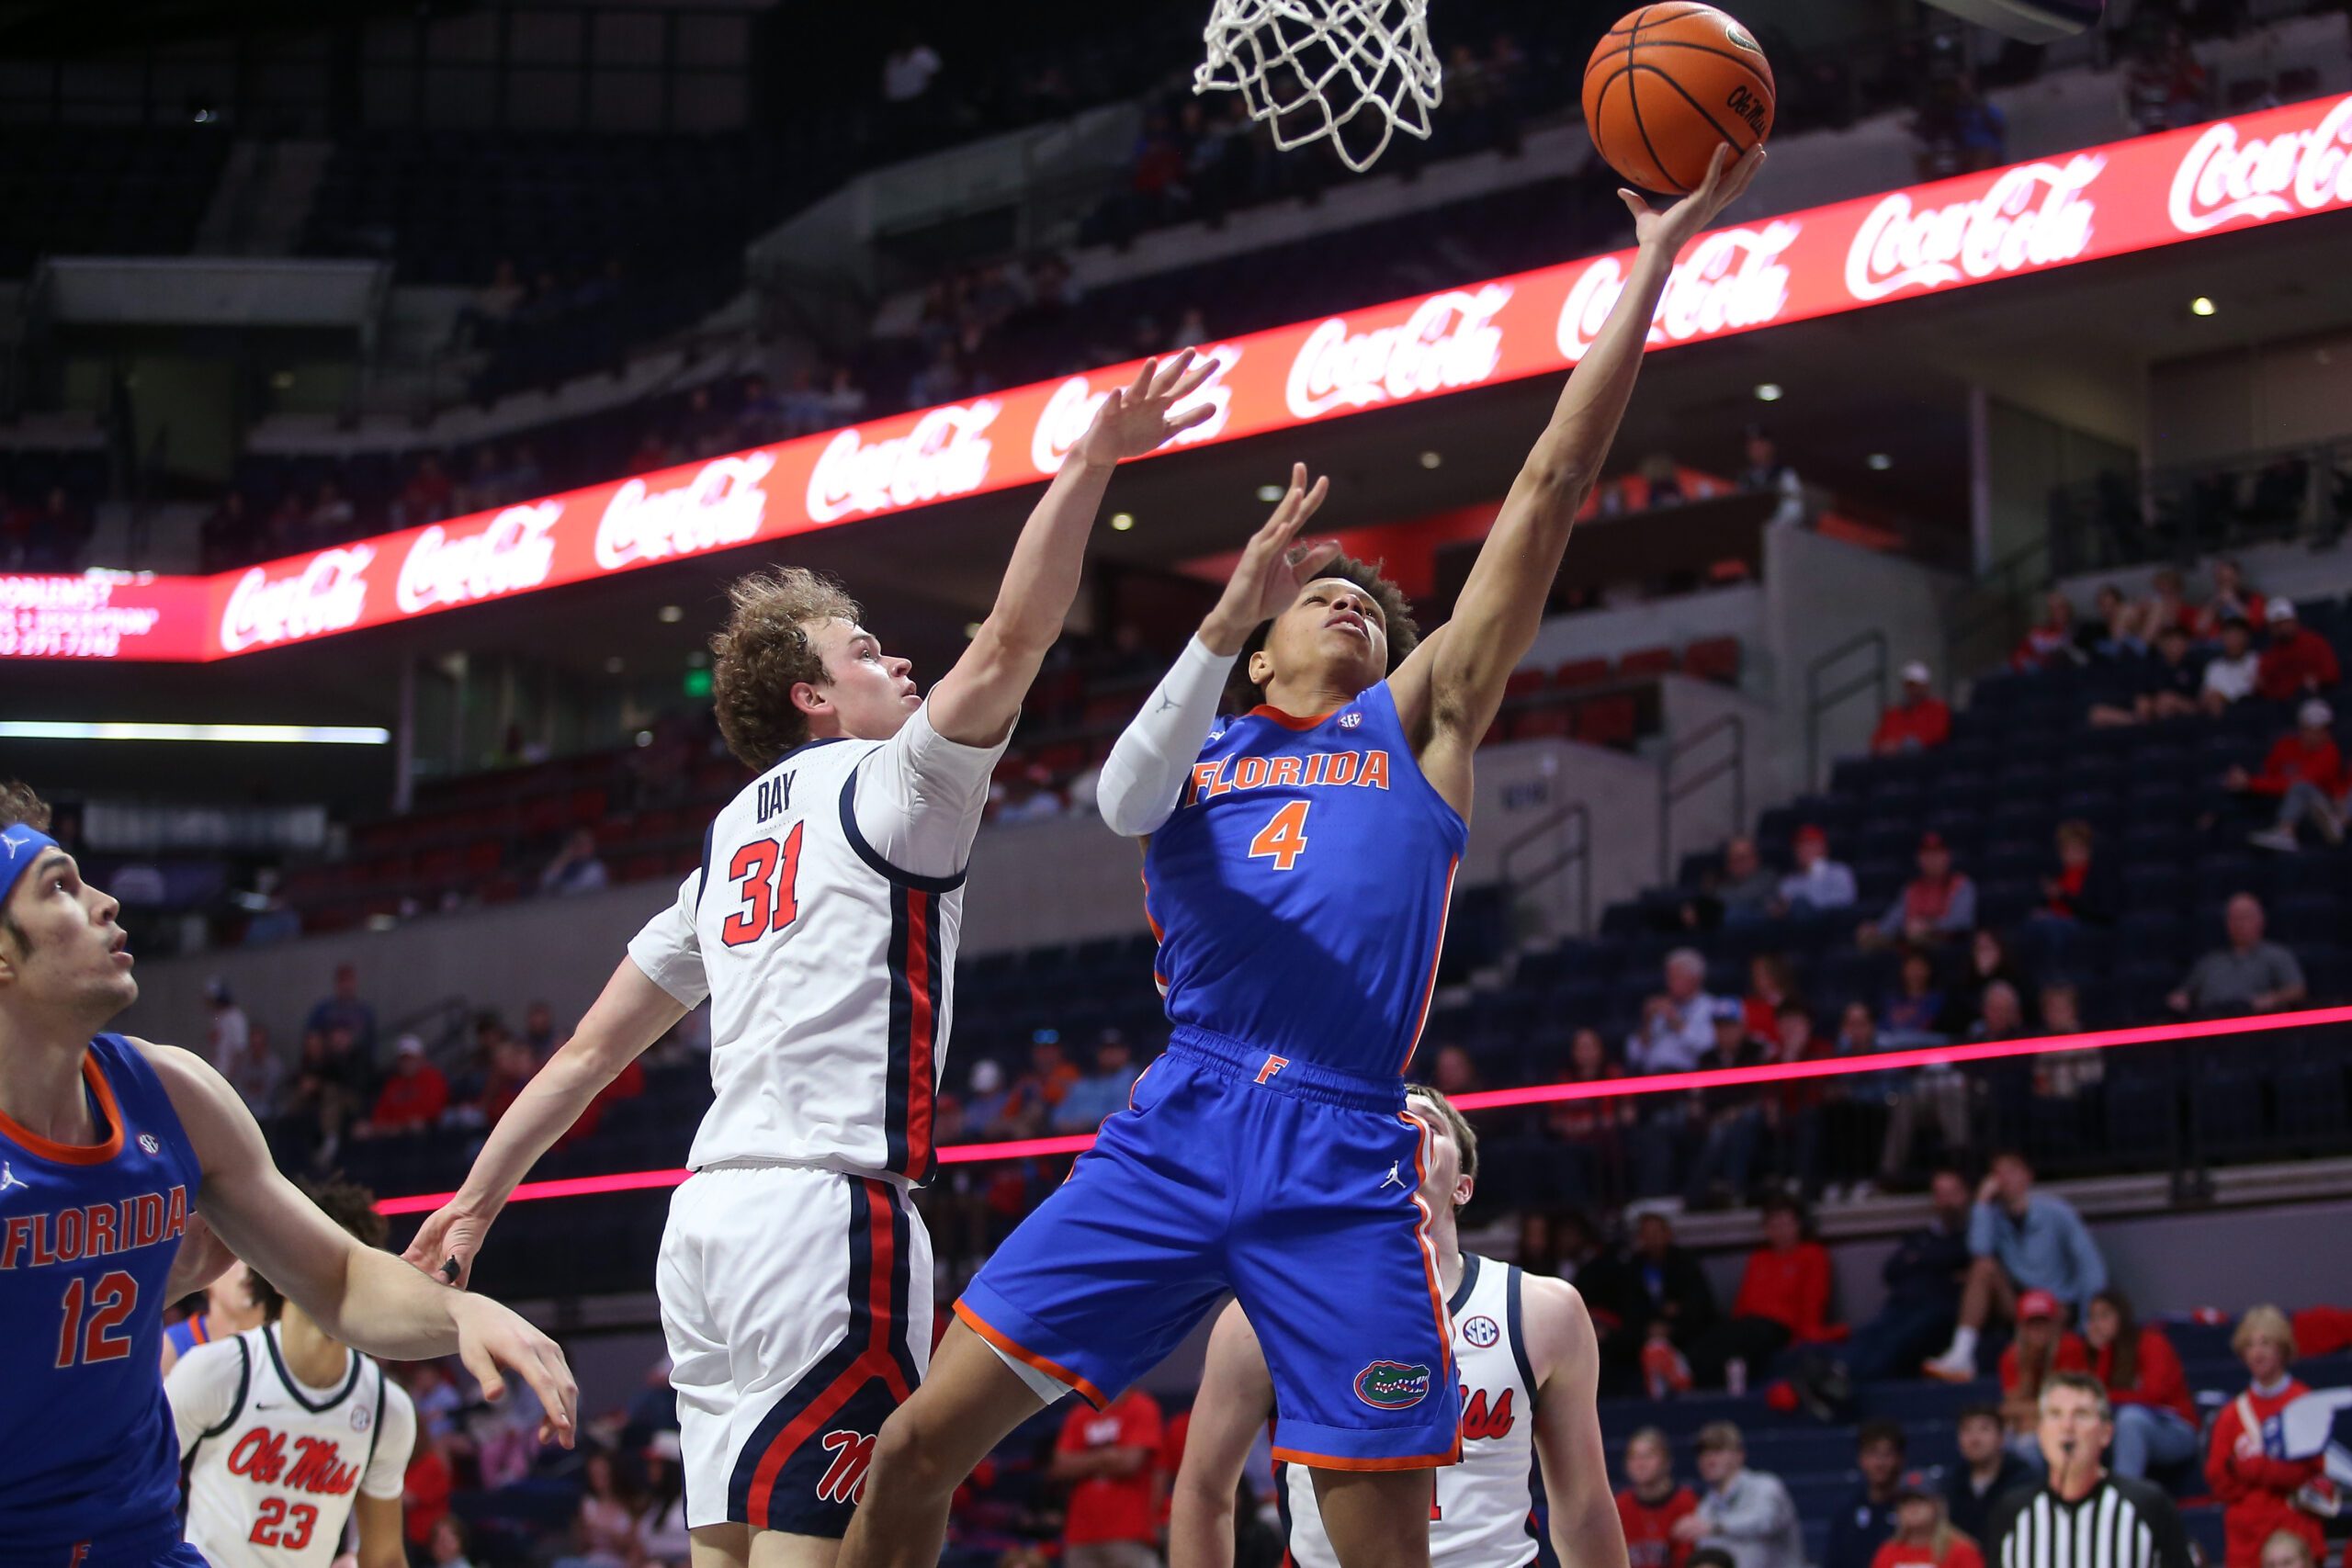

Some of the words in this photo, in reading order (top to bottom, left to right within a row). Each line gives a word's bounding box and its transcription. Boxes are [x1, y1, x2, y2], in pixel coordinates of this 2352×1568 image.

[1339, 711, 1363, 729] SEC
[757, 770, 797, 824] DAY
[1183, 750, 1391, 808] FLORIDA
[1248, 800, 1313, 871] 4
[721, 819, 804, 948] 31
[1253, 1054, 1290, 1085] F
[0, 1184, 187, 1270] FLORIDA
[54, 1269, 139, 1369] 12
[1464, 1317, 1498, 1347] SEC
[1457, 1384, 1516, 1441] ss
[228, 1427, 288, 1484] Ole
[283, 1436, 361, 1496] Miss
[249, 1497, 319, 1551] 23
